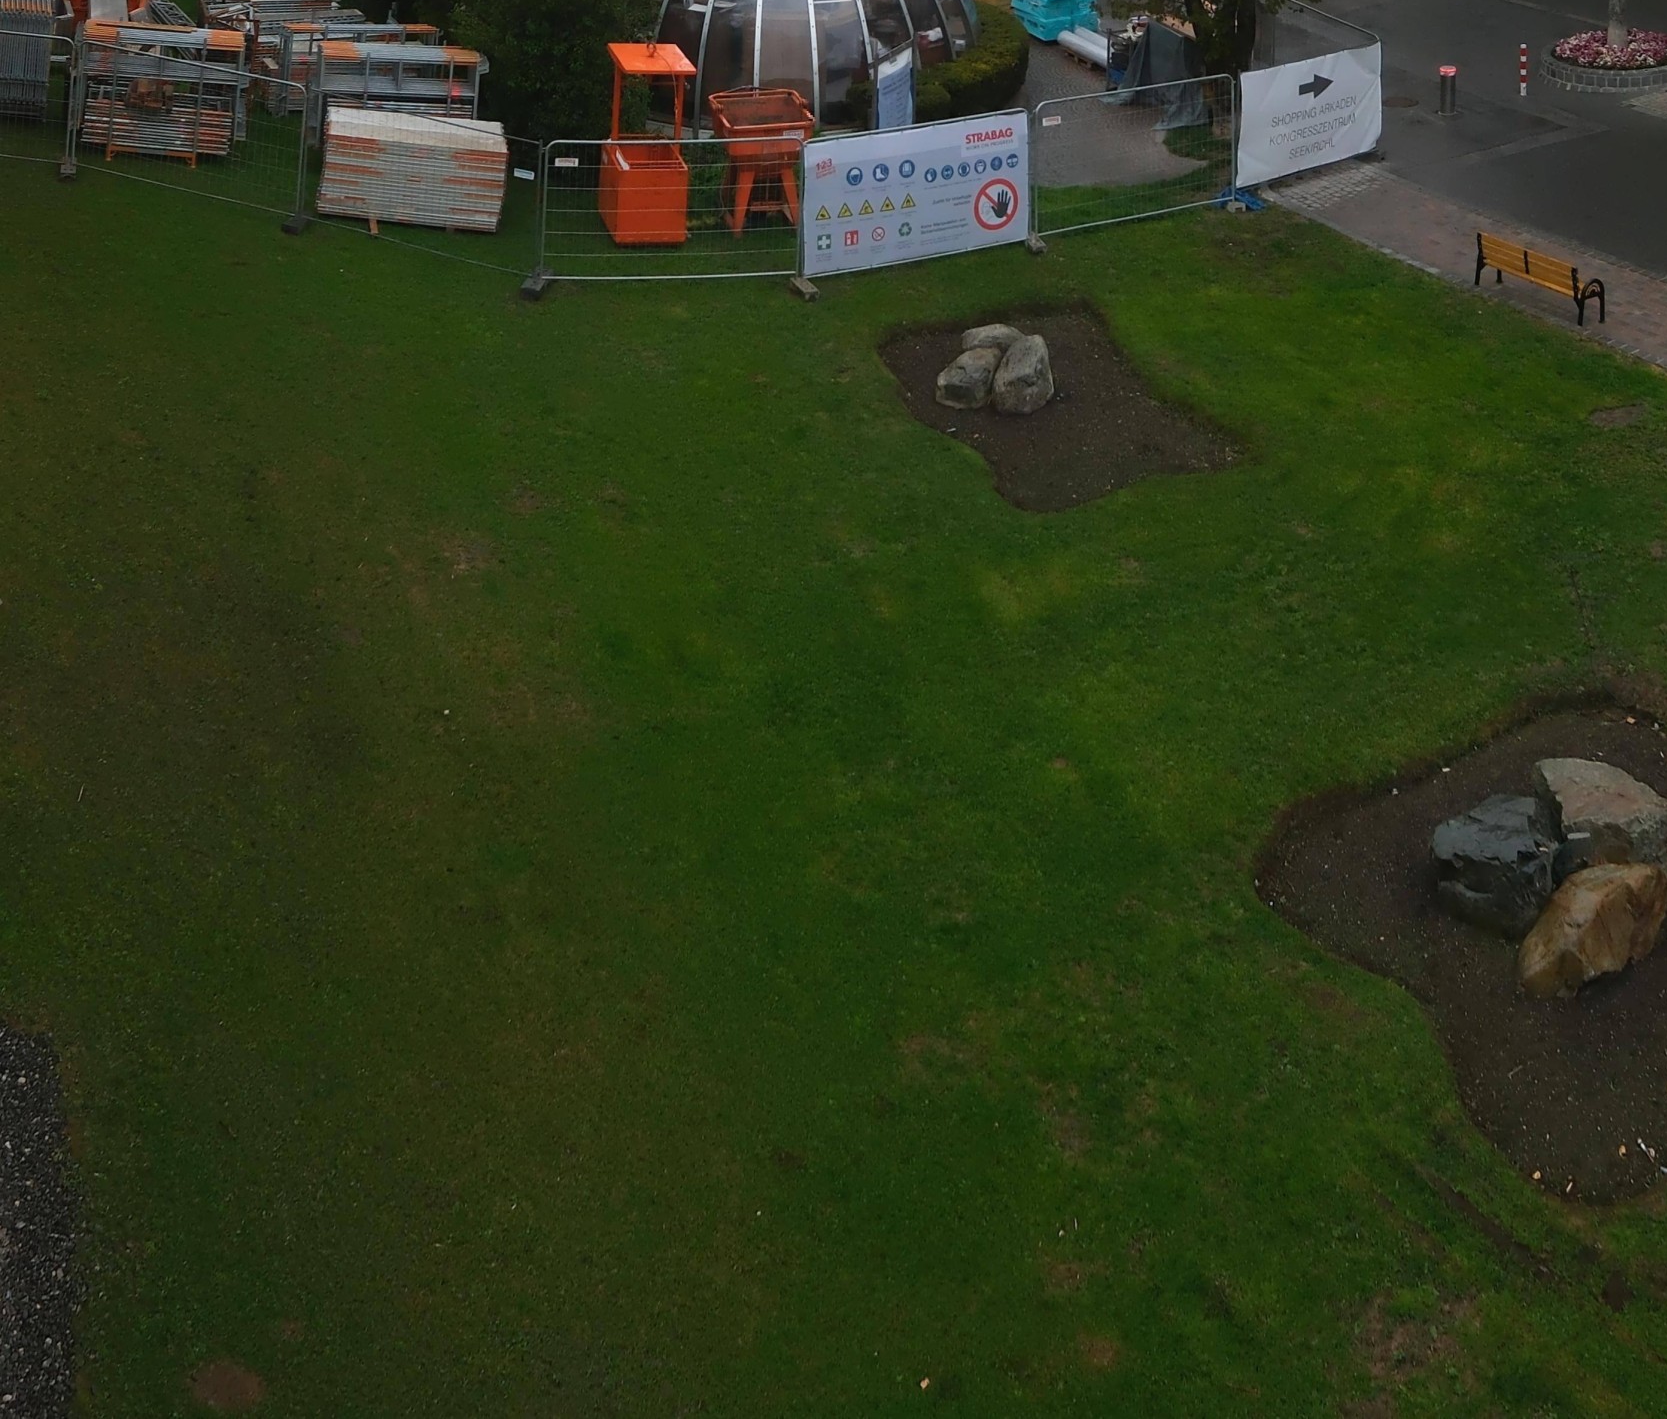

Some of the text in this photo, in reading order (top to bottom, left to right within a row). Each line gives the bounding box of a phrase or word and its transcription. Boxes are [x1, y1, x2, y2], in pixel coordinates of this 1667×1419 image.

[1271, 95, 1357, 128] SHOPPING ARKADEN
[965, 127, 1013, 144] STRABAG
[1269, 113, 1356, 147] KONGRESSZENTRUM
[1288, 141, 1336, 160] SEEKIRCHL
